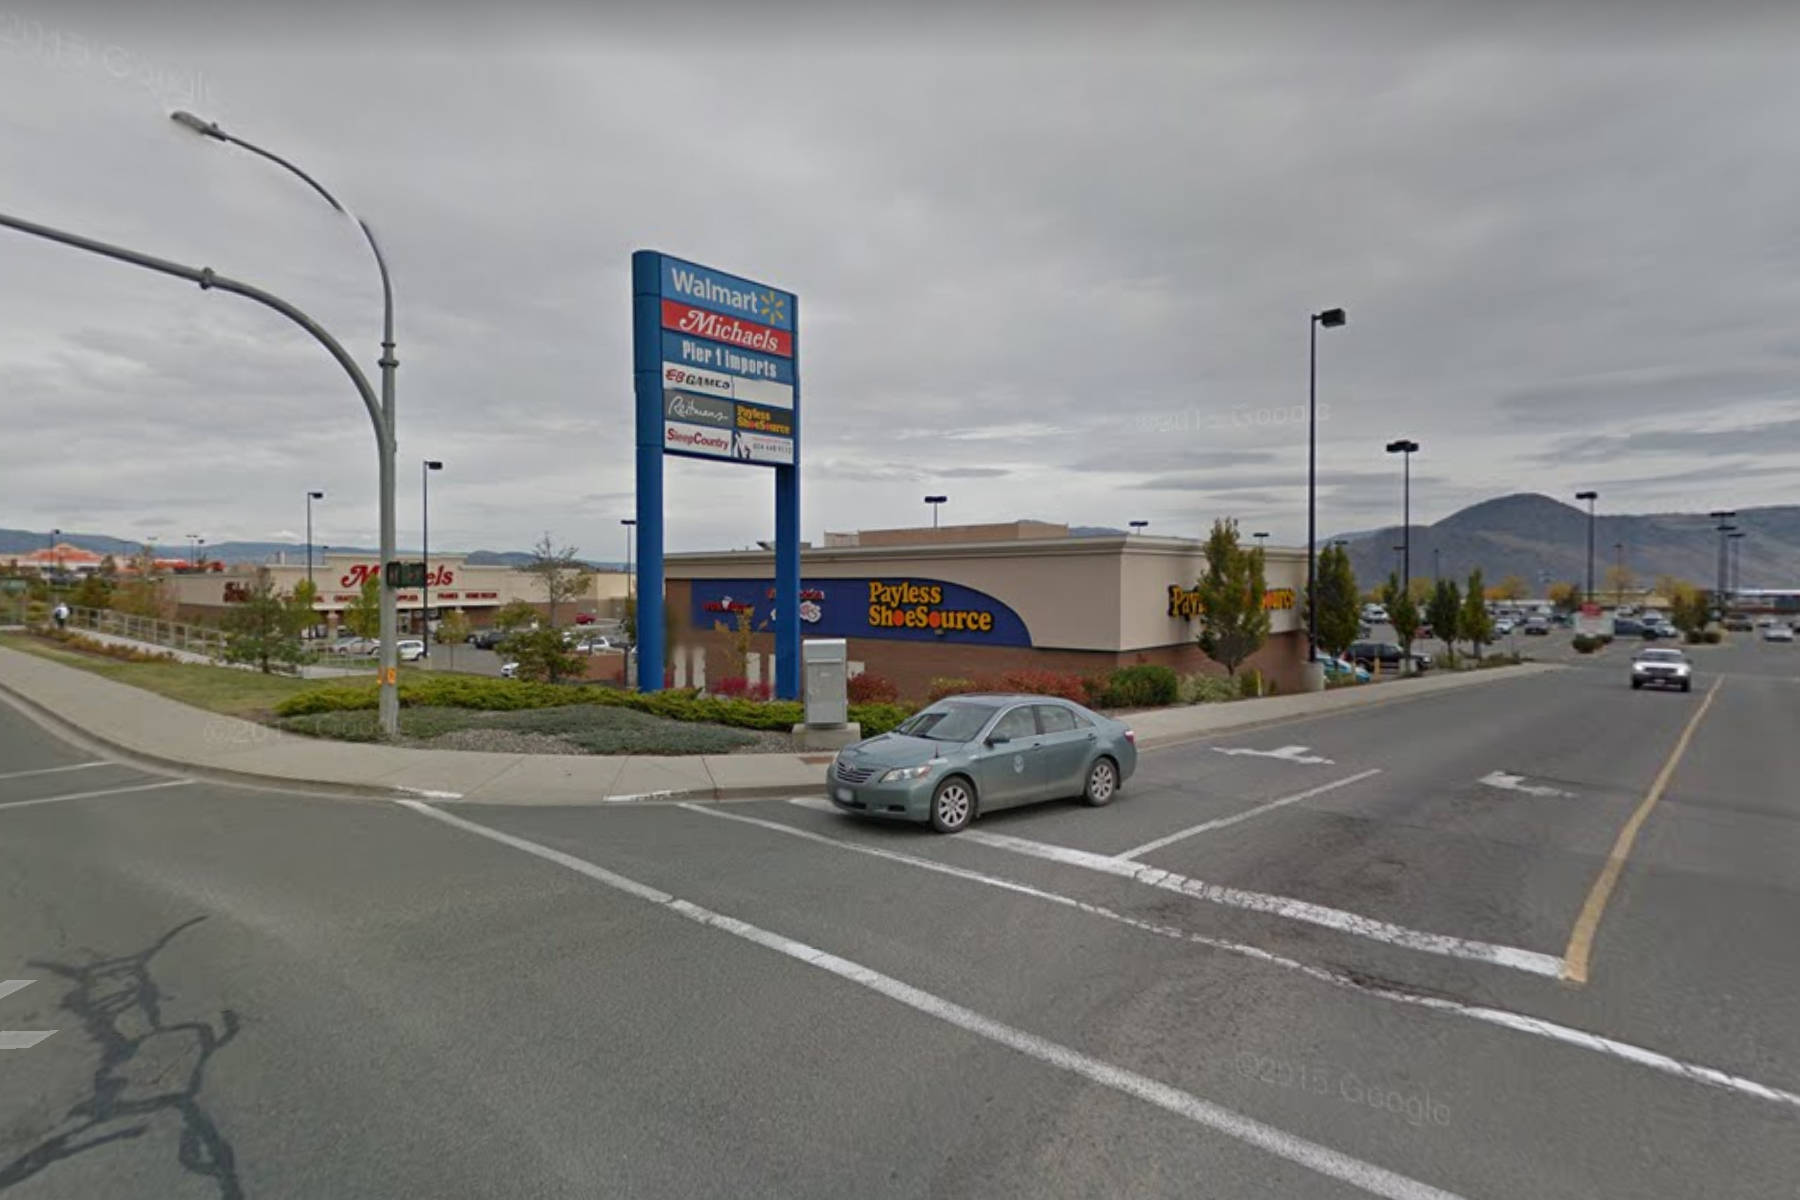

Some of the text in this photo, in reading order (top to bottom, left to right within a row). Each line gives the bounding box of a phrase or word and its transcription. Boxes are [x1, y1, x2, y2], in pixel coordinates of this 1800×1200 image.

[671, 267, 758, 314] Walmart
[680, 309, 779, 352] Michaels
[682, 339, 712, 364] Pier
[715, 347, 722, 367] 1
[869, 581, 942, 608] Payless
[868, 604, 992, 631] ShoeSource
